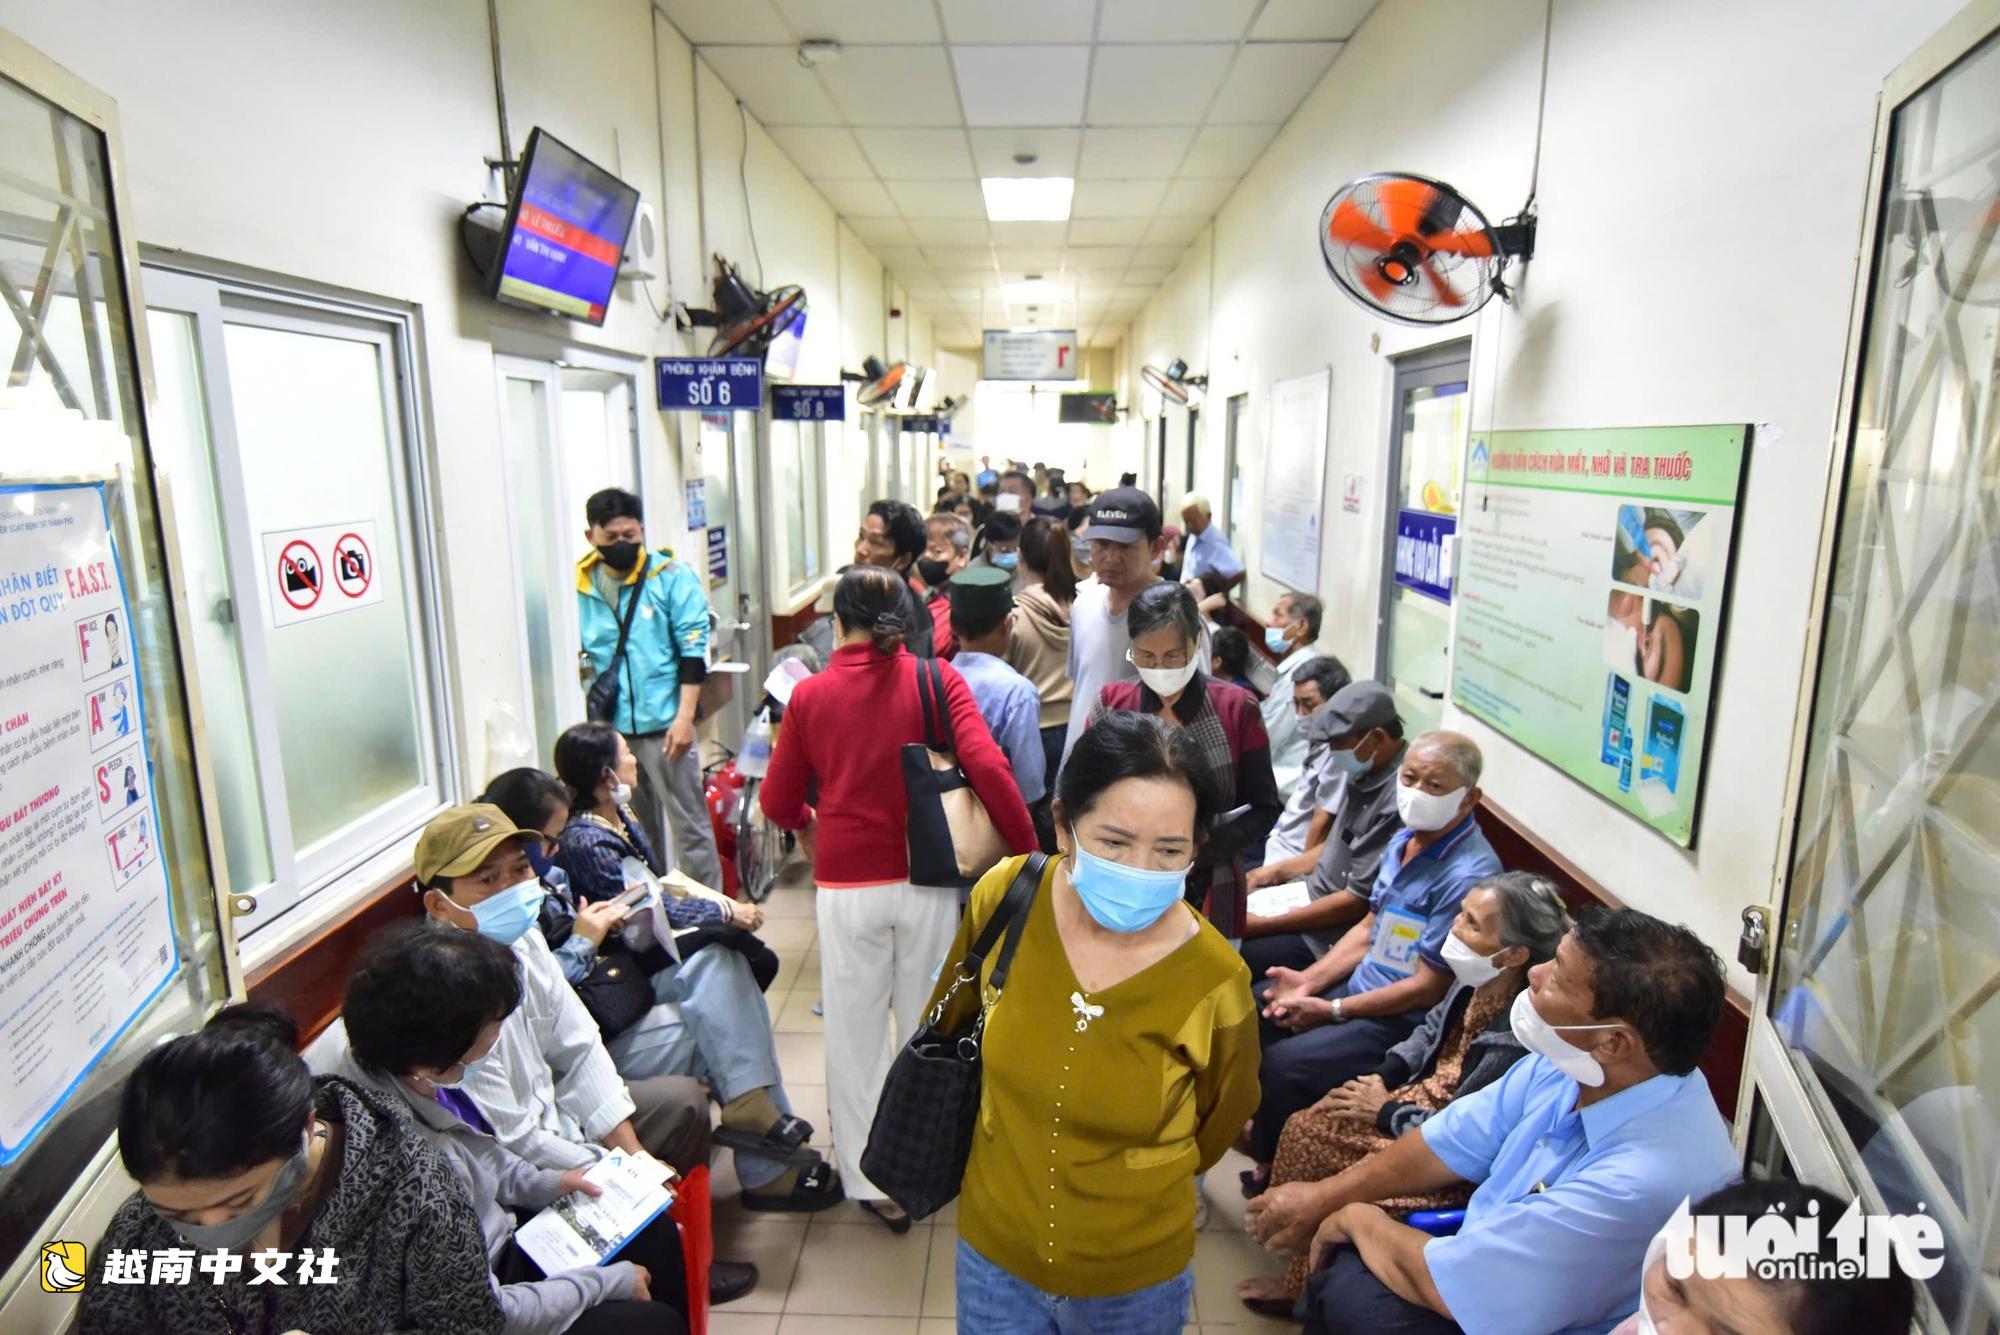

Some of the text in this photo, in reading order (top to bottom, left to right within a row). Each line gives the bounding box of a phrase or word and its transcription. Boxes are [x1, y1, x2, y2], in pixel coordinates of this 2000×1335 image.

[662, 362, 757, 376] PHÒNG KHÁM BỆNH
[688, 377, 731, 405] SỐ 6
[793, 398, 825, 418] SỐ 8
[1591, 449, 1611, 477] NHỎ
[1613, 451, 1626, 478] VÀ
[1630, 455, 1650, 479] TRA
[1653, 450, 1692, 482] THUỐC
[1096, 510, 1127, 519] ELEVEN
[0, 563, 59, 597] HẬN BIẾT
[64, 561, 112, 599] F.A.S.T.
[10, 597, 37, 621] ĐỘT
